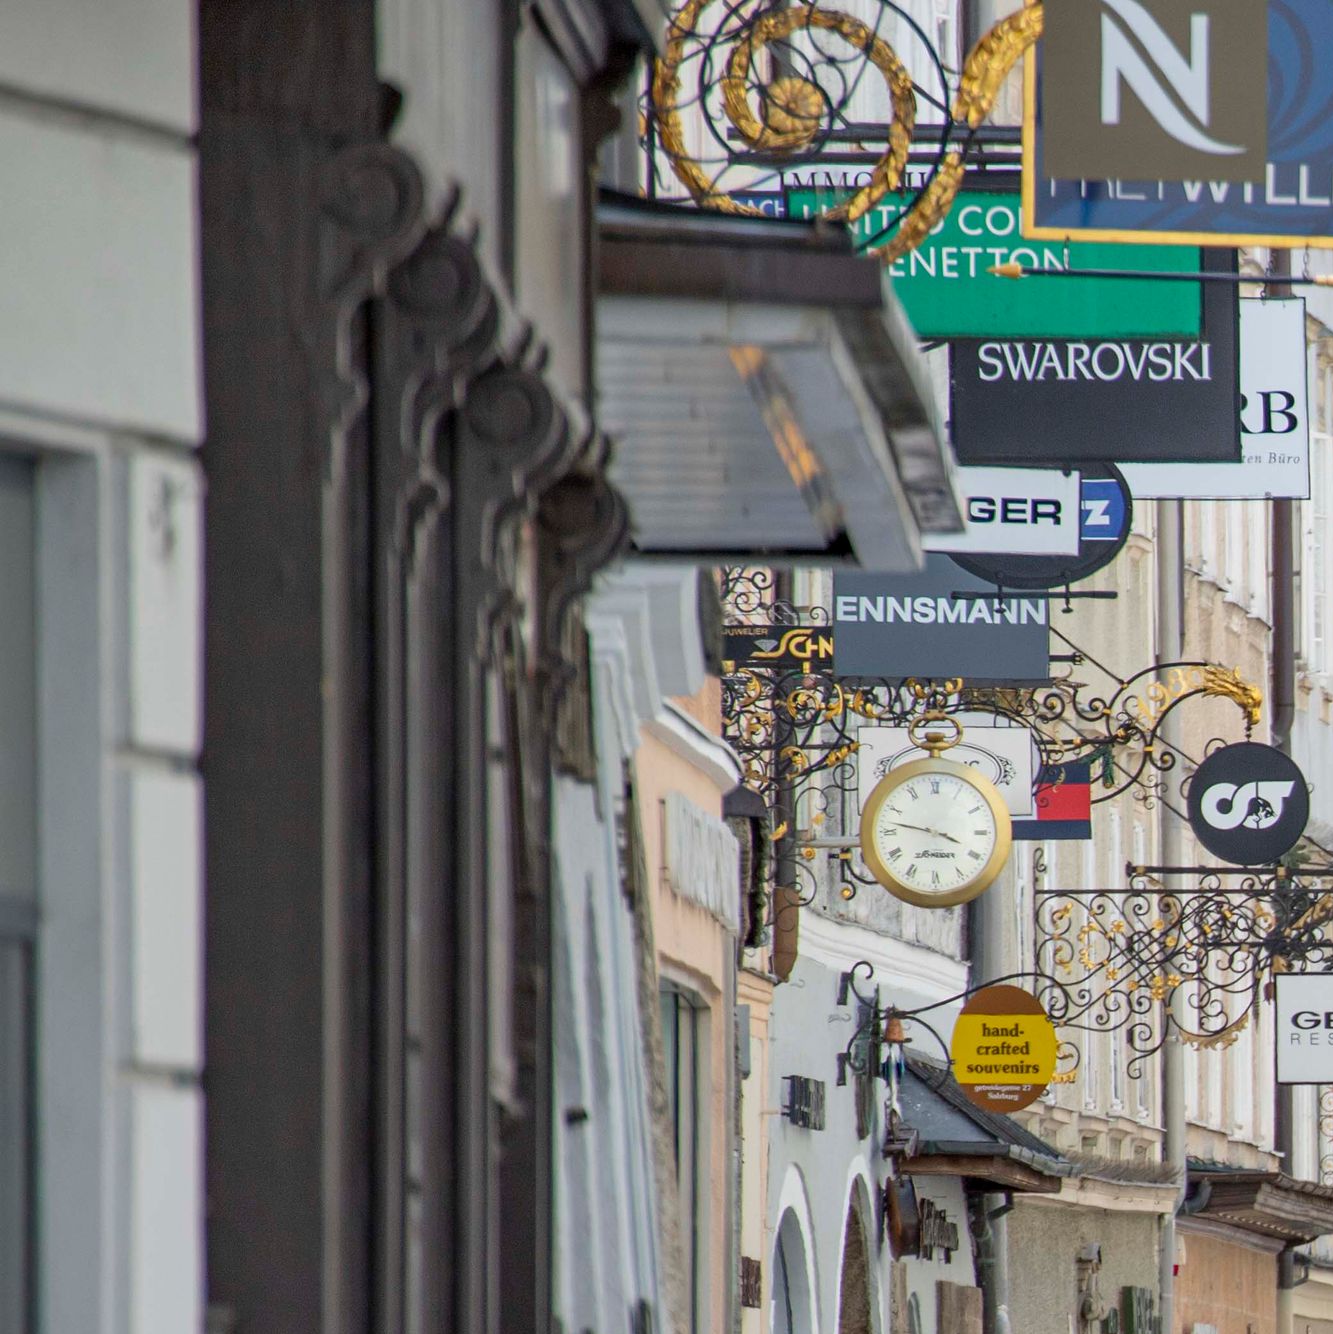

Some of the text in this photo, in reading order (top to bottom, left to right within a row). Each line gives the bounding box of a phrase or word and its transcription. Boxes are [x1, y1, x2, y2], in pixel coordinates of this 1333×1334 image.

[958, 205, 1023, 236] CO
[868, 246, 1068, 278] ENETTON
[978, 342, 1212, 381] SWAROVSKI
[1269, 450, 1300, 465] Büro
[836, 595, 1047, 625] ENNSMANN
[982, 1023, 1024, 1037] hand-
[976, 1041, 1030, 1055] crafted
[966, 1060, 1040, 1074] souvenirs
